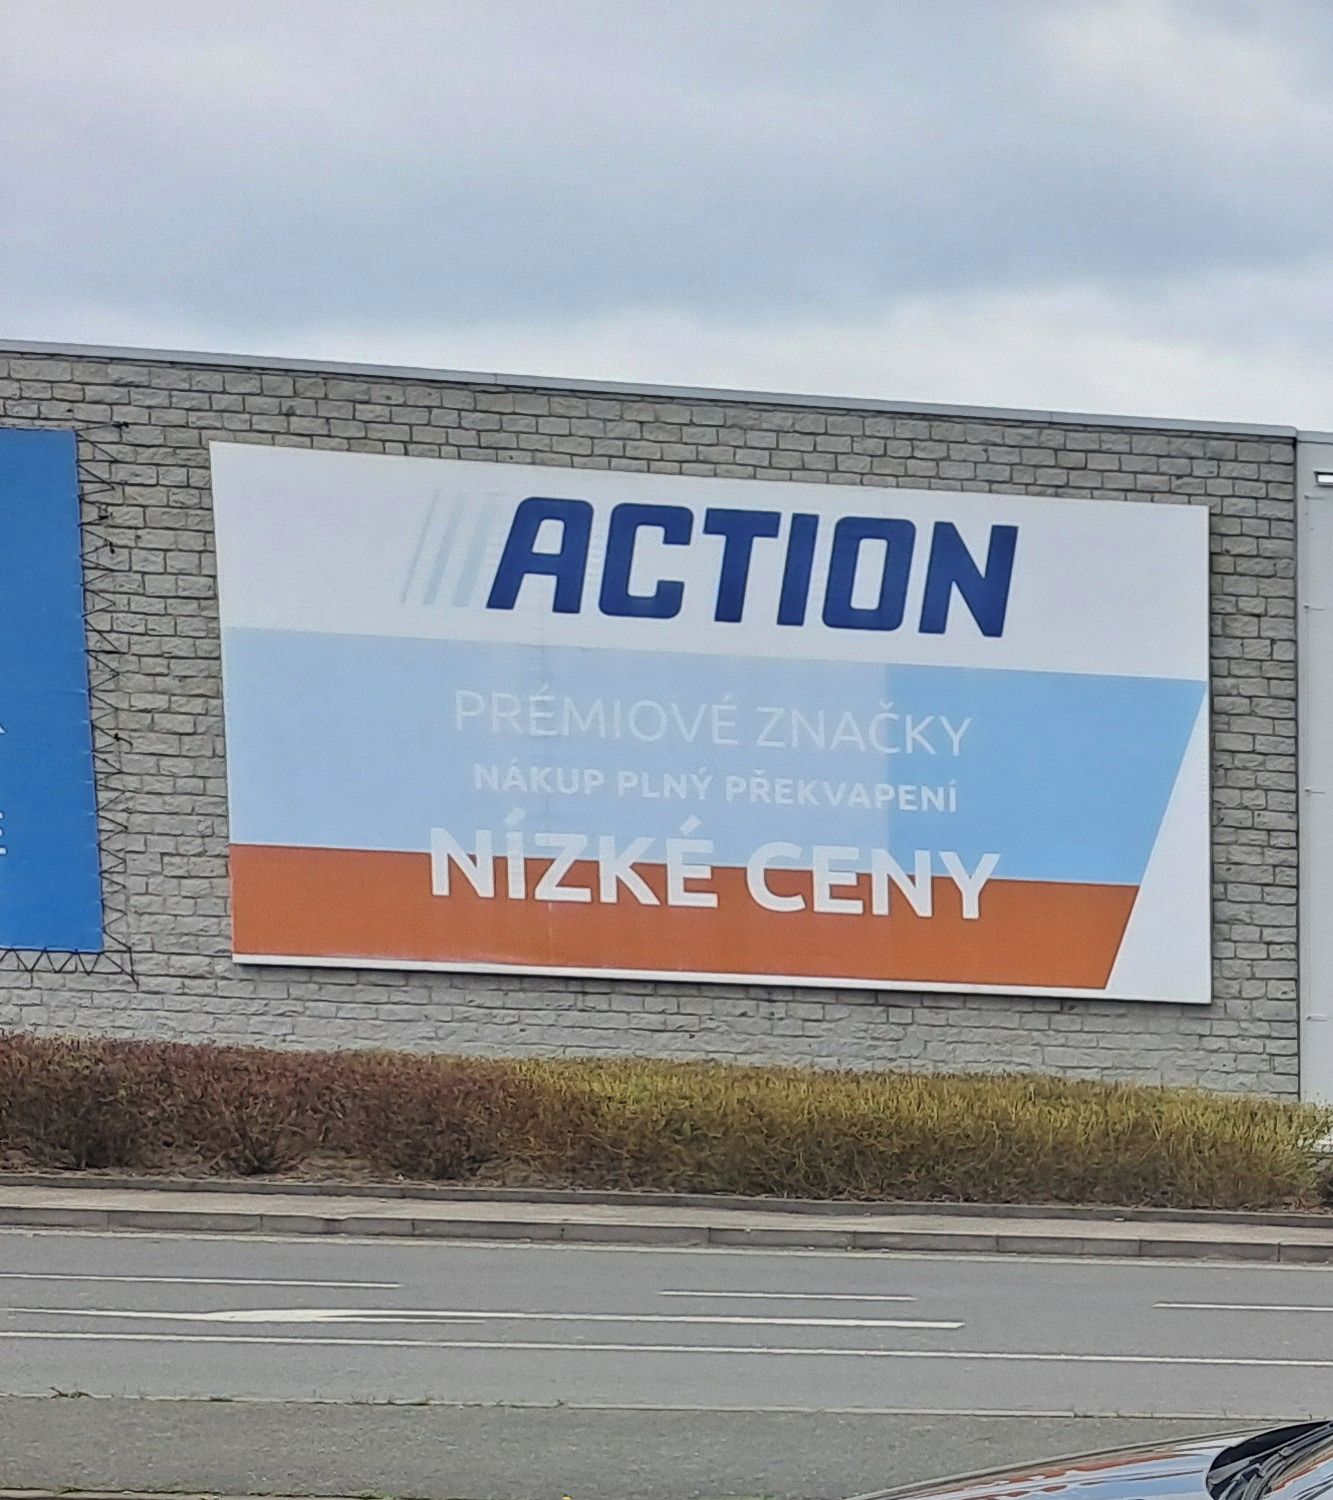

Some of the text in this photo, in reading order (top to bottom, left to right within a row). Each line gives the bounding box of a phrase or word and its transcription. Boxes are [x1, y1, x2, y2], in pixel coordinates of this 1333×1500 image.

[486, 496, 1019, 638] ACTION
[455, 684, 972, 756] PRÉMIOVÉ ZNAČKY
[473, 757, 958, 813] NÁKUP PLNÝ PŘEKVAPENÍ
[430, 808, 1001, 919] NÍZKÉ CENY
